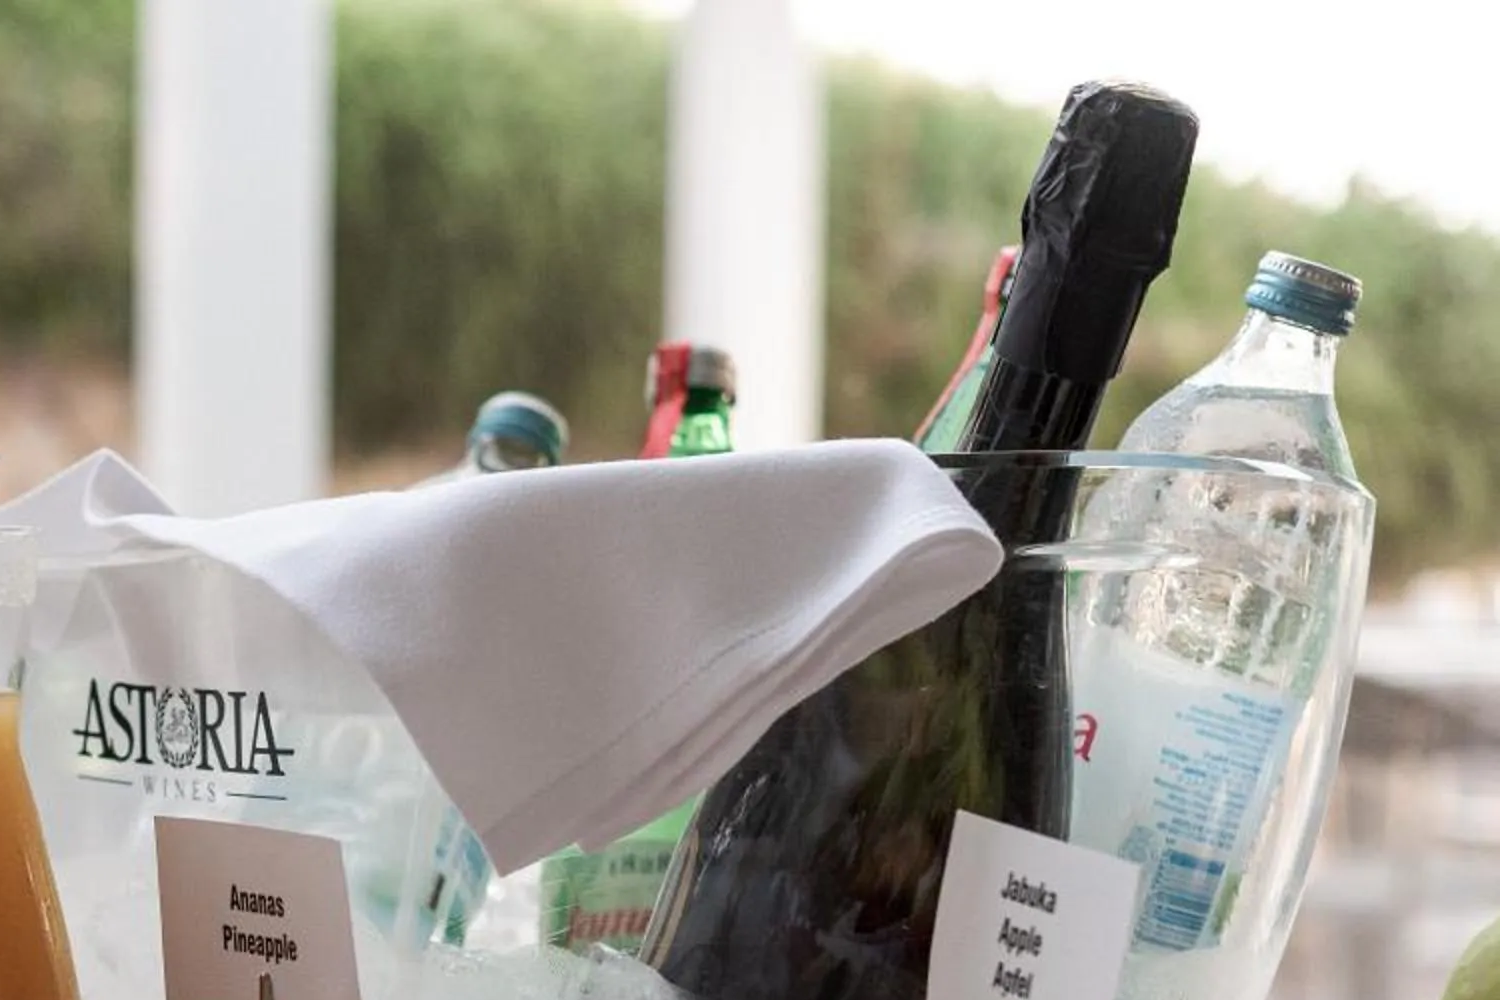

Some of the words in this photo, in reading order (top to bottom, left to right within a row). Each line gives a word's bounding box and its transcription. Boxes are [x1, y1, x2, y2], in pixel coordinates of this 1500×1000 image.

[73, 677, 295, 777] ASTORIA
[143, 774, 217, 802] WINES
[230, 883, 285, 917] Ananas
[1001, 870, 1057, 914] Jabuka
[222, 923, 298, 965] Pineapple
[998, 916, 1043, 957] Apple
